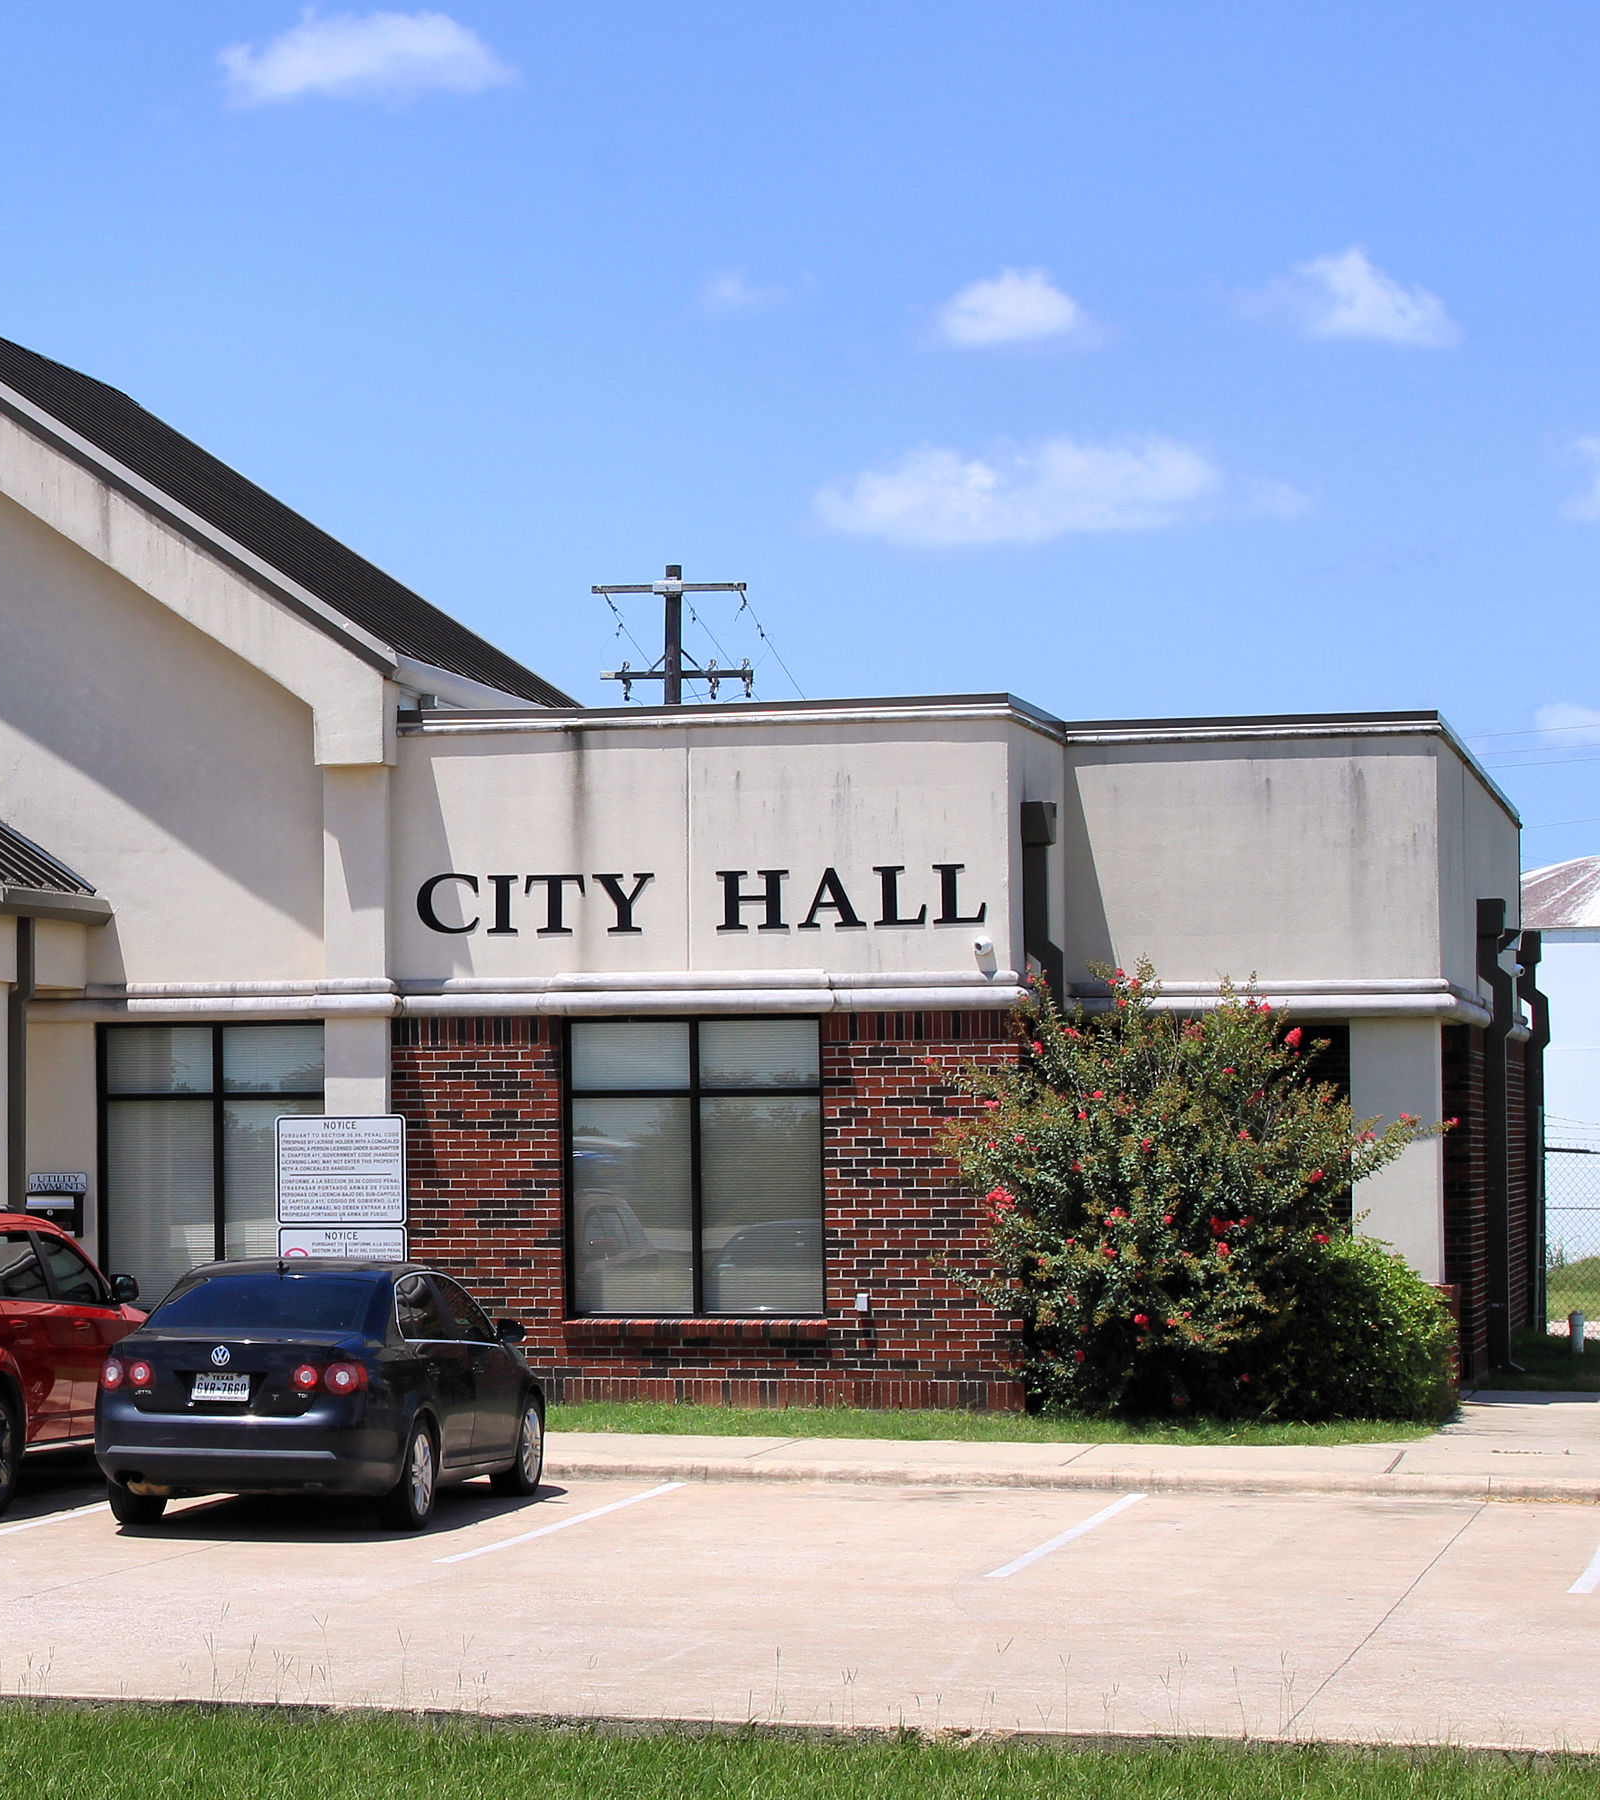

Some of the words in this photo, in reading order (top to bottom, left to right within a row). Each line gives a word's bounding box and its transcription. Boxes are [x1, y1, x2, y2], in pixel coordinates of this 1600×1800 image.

[416, 872, 656, 935] CITY
[715, 864, 987, 932] HALL
[323, 1121, 357, 1130] NOTICE
[324, 1231, 358, 1241] NOTICE
